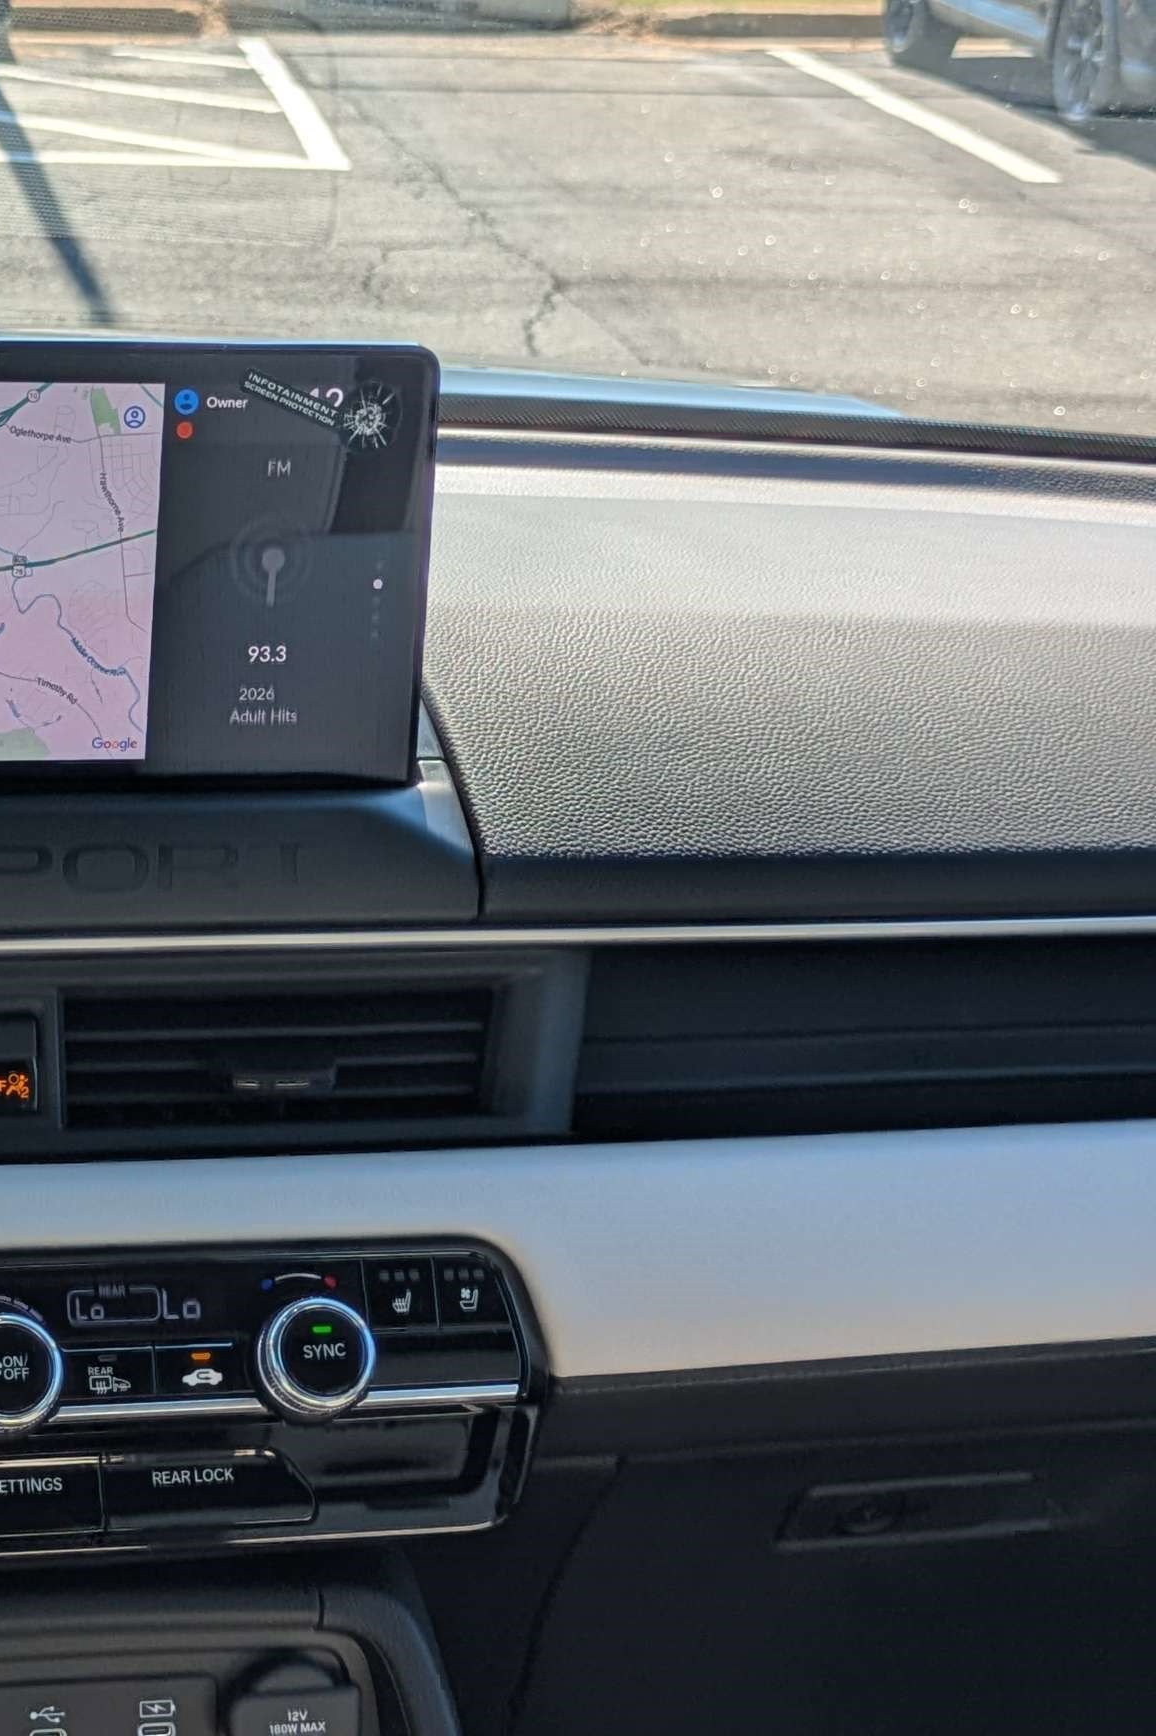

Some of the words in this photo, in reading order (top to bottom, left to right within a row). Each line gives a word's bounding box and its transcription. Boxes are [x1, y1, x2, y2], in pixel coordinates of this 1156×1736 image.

[206, 396, 249, 409] Owner
[244, 380, 279, 402] SCREEN
[279, 397, 335, 427] PROTECTION
[248, 372, 339, 417] INFOTAINMENT
[9, 424, 55, 444] Oglethorpe
[55, 433, 72, 444] Ave
[267, 459, 292, 477] FM
[248, 645, 287, 663] 93.3
[36, 677, 67, 697] Timothy
[239, 687, 275, 702] 2026
[229, 707, 267, 725] Adult
[270, 707, 298, 725] Hits
[91, 737, 137, 752] Google
[302, 1342, 347, 1361] SYNC
[2, 1355, 29, 1368] ON/
[3, 1367, 30, 1381] OFF
[87, 1366, 114, 1376] REAR
[152, 1469, 191, 1487] REAR
[194, 1467, 235, 1485] LOCK
[287, 1708, 309, 1722] 12V
[299, 1721, 327, 1734] MAX
